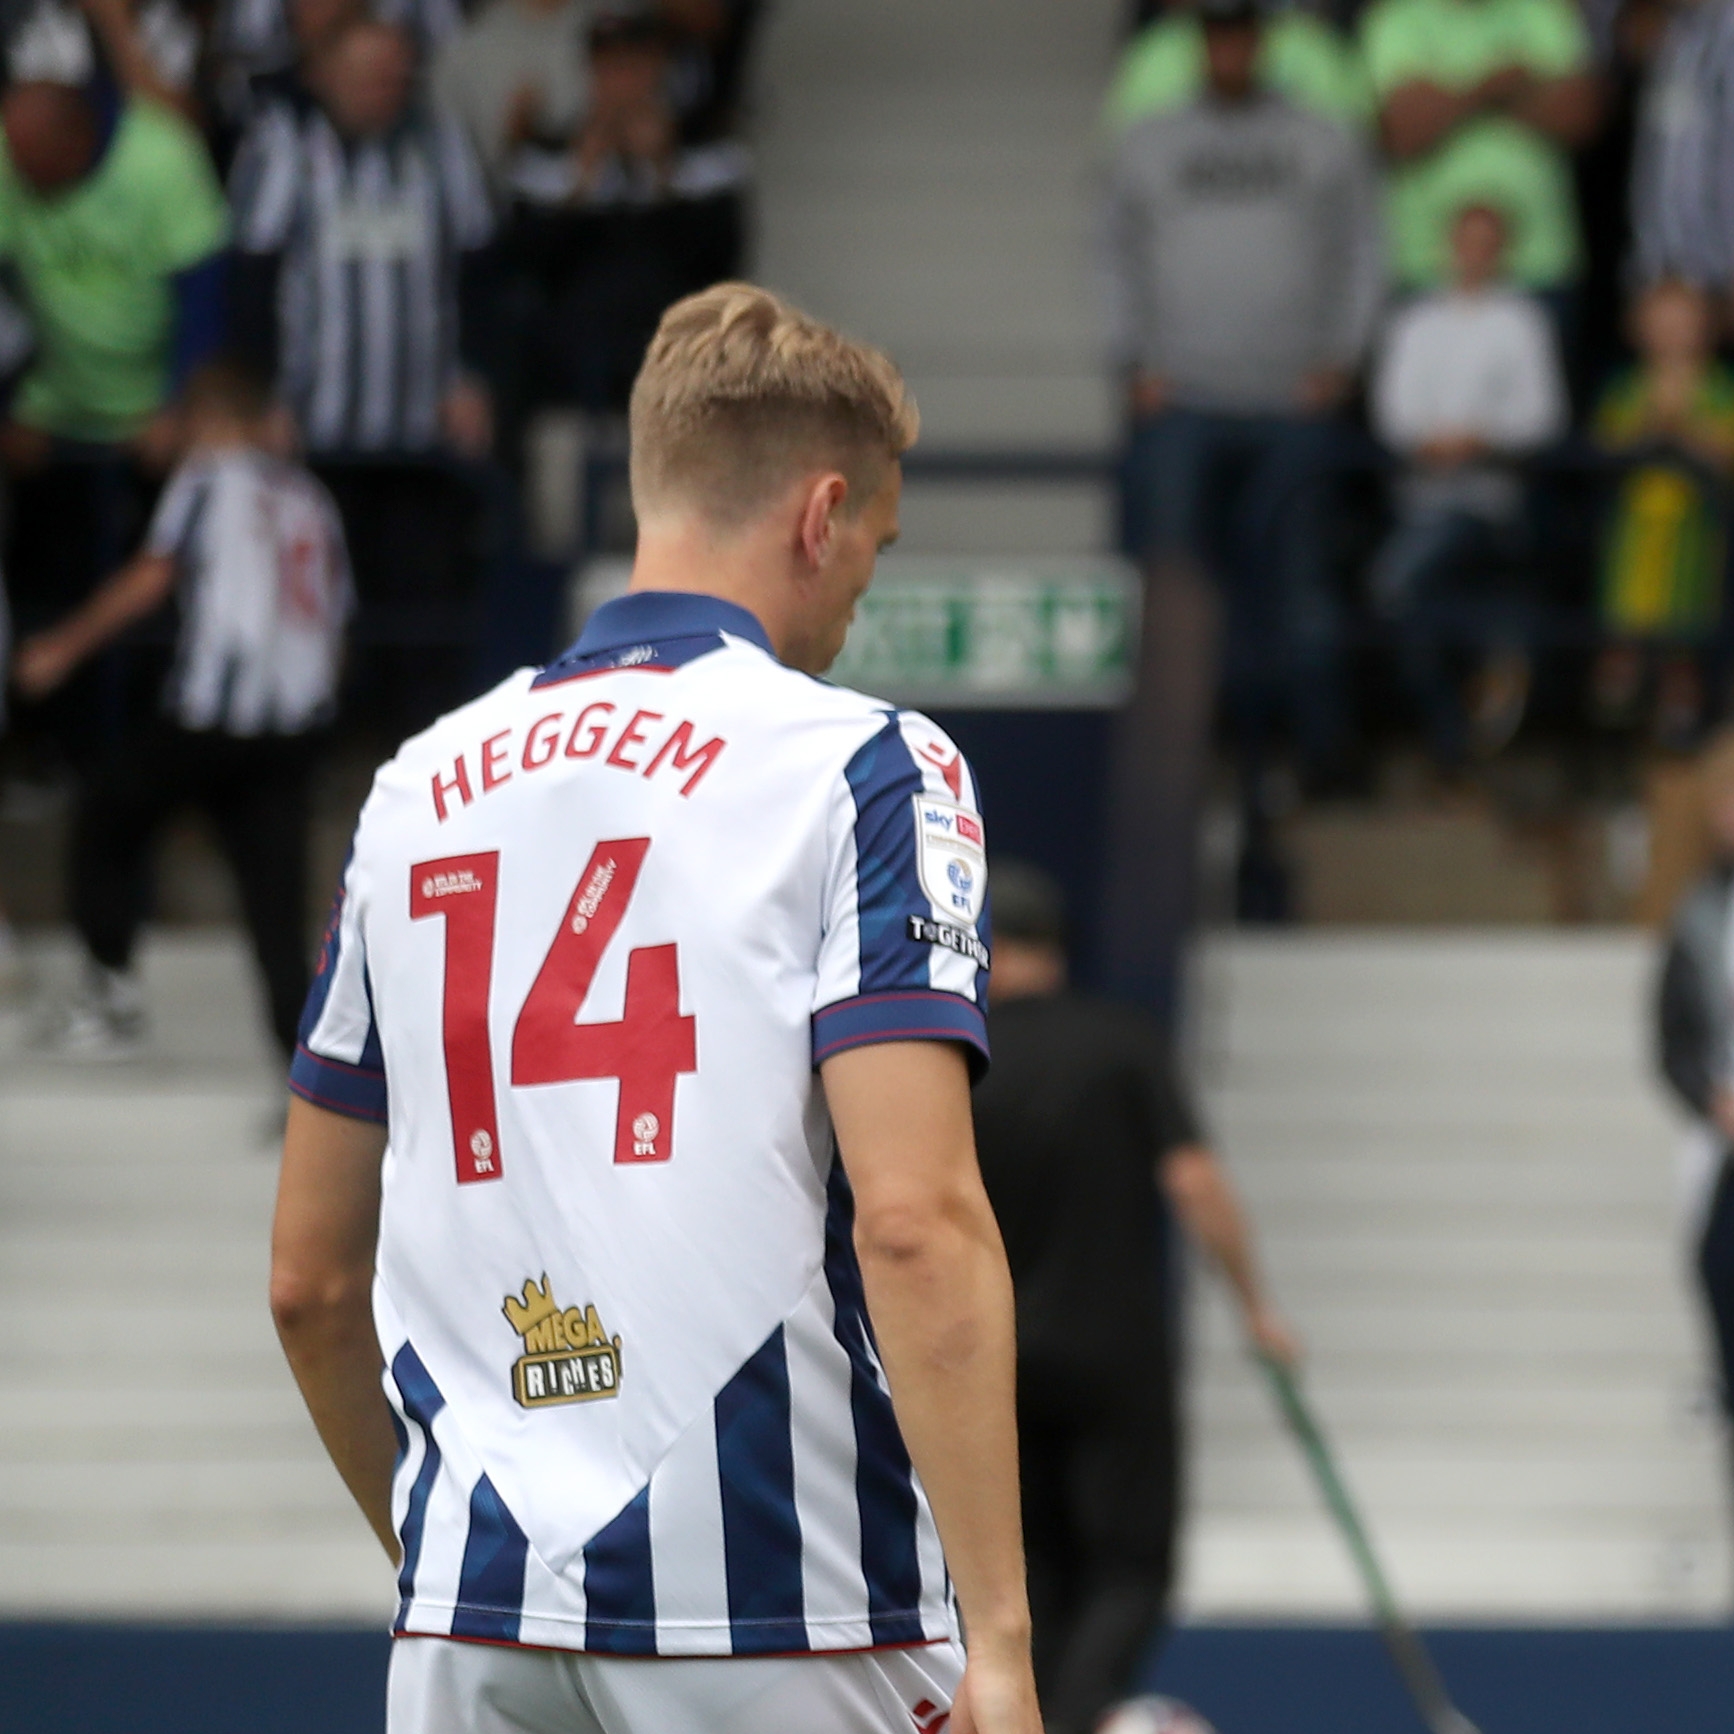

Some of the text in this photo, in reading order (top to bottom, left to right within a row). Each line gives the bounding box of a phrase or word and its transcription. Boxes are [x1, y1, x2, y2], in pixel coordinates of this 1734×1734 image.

[431, 701, 728, 826] HEGGEM
[924, 808, 953, 832] sky
[409, 836, 698, 1185] 14
[474, 1159, 495, 1174] EFL
[633, 1141, 656, 1156] EFL
[524, 1303, 608, 1355] MEGA
[525, 1353, 616, 1398] RICHES
